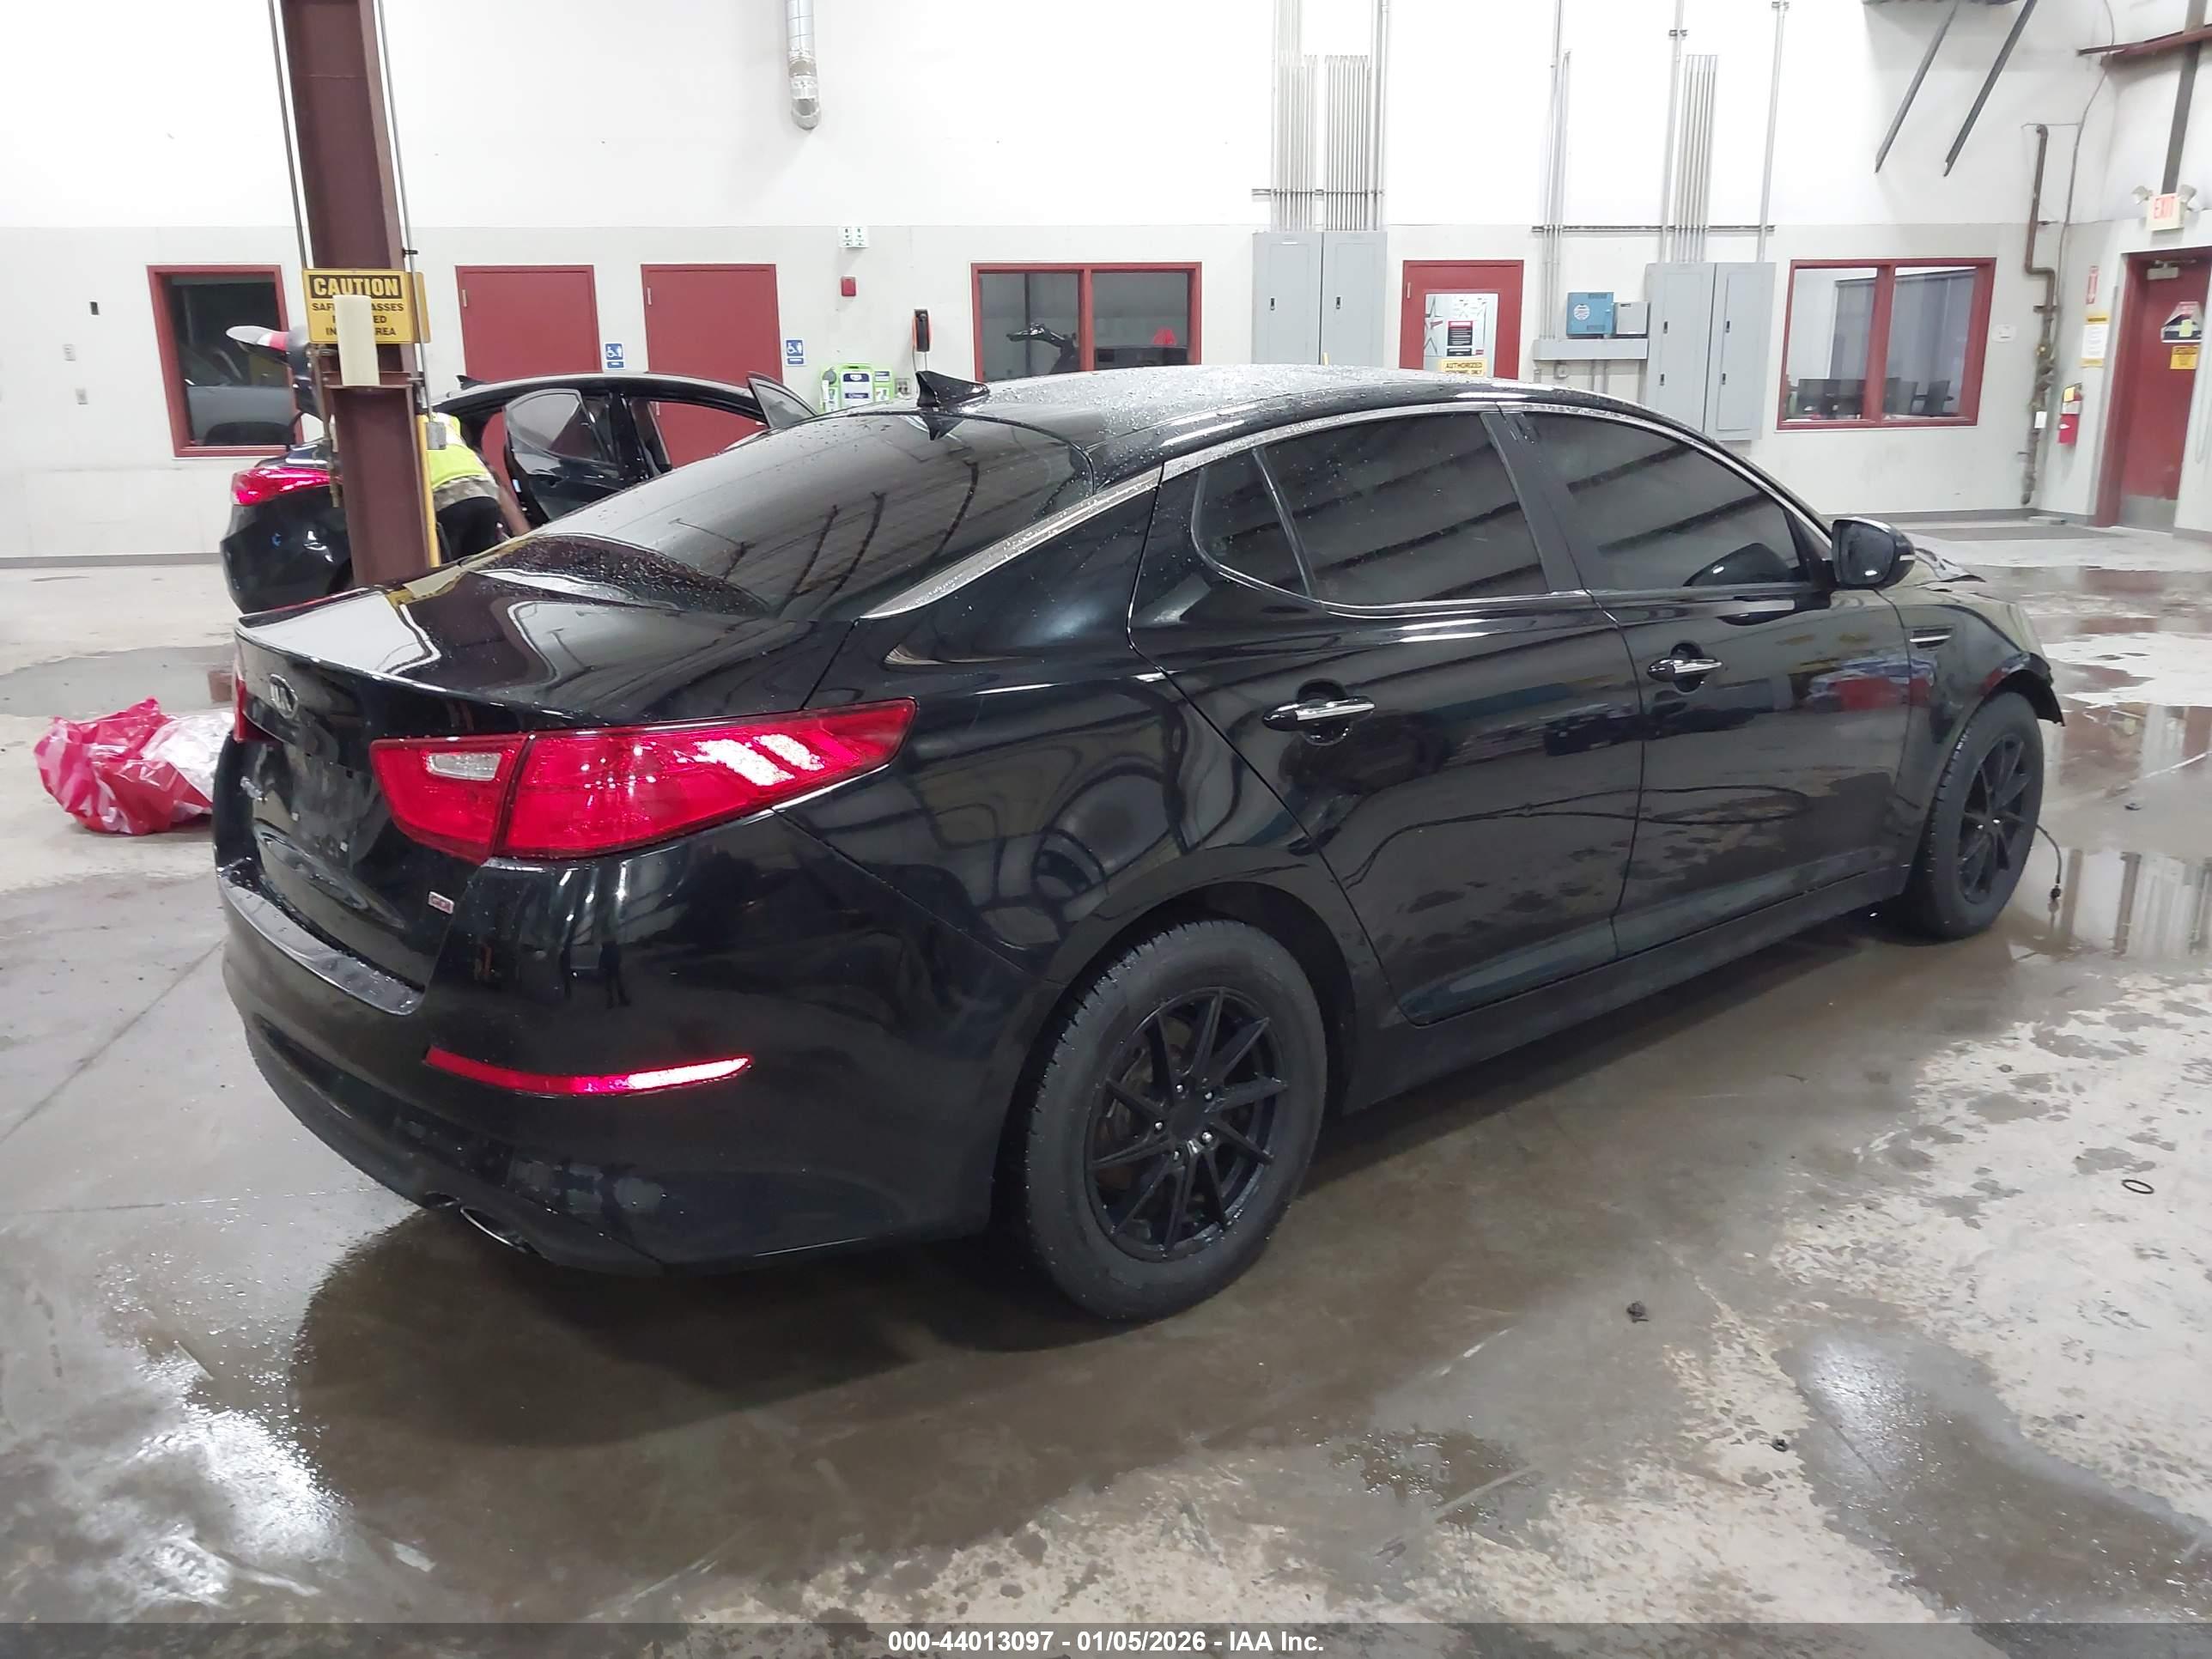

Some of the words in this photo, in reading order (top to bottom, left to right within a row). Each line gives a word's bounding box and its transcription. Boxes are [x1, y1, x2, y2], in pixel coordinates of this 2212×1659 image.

[313, 277, 399, 296] CAUTION
[312, 302, 335, 311] SAF
[371, 302, 404, 312] ASSES
[374, 327, 397, 336] REA
